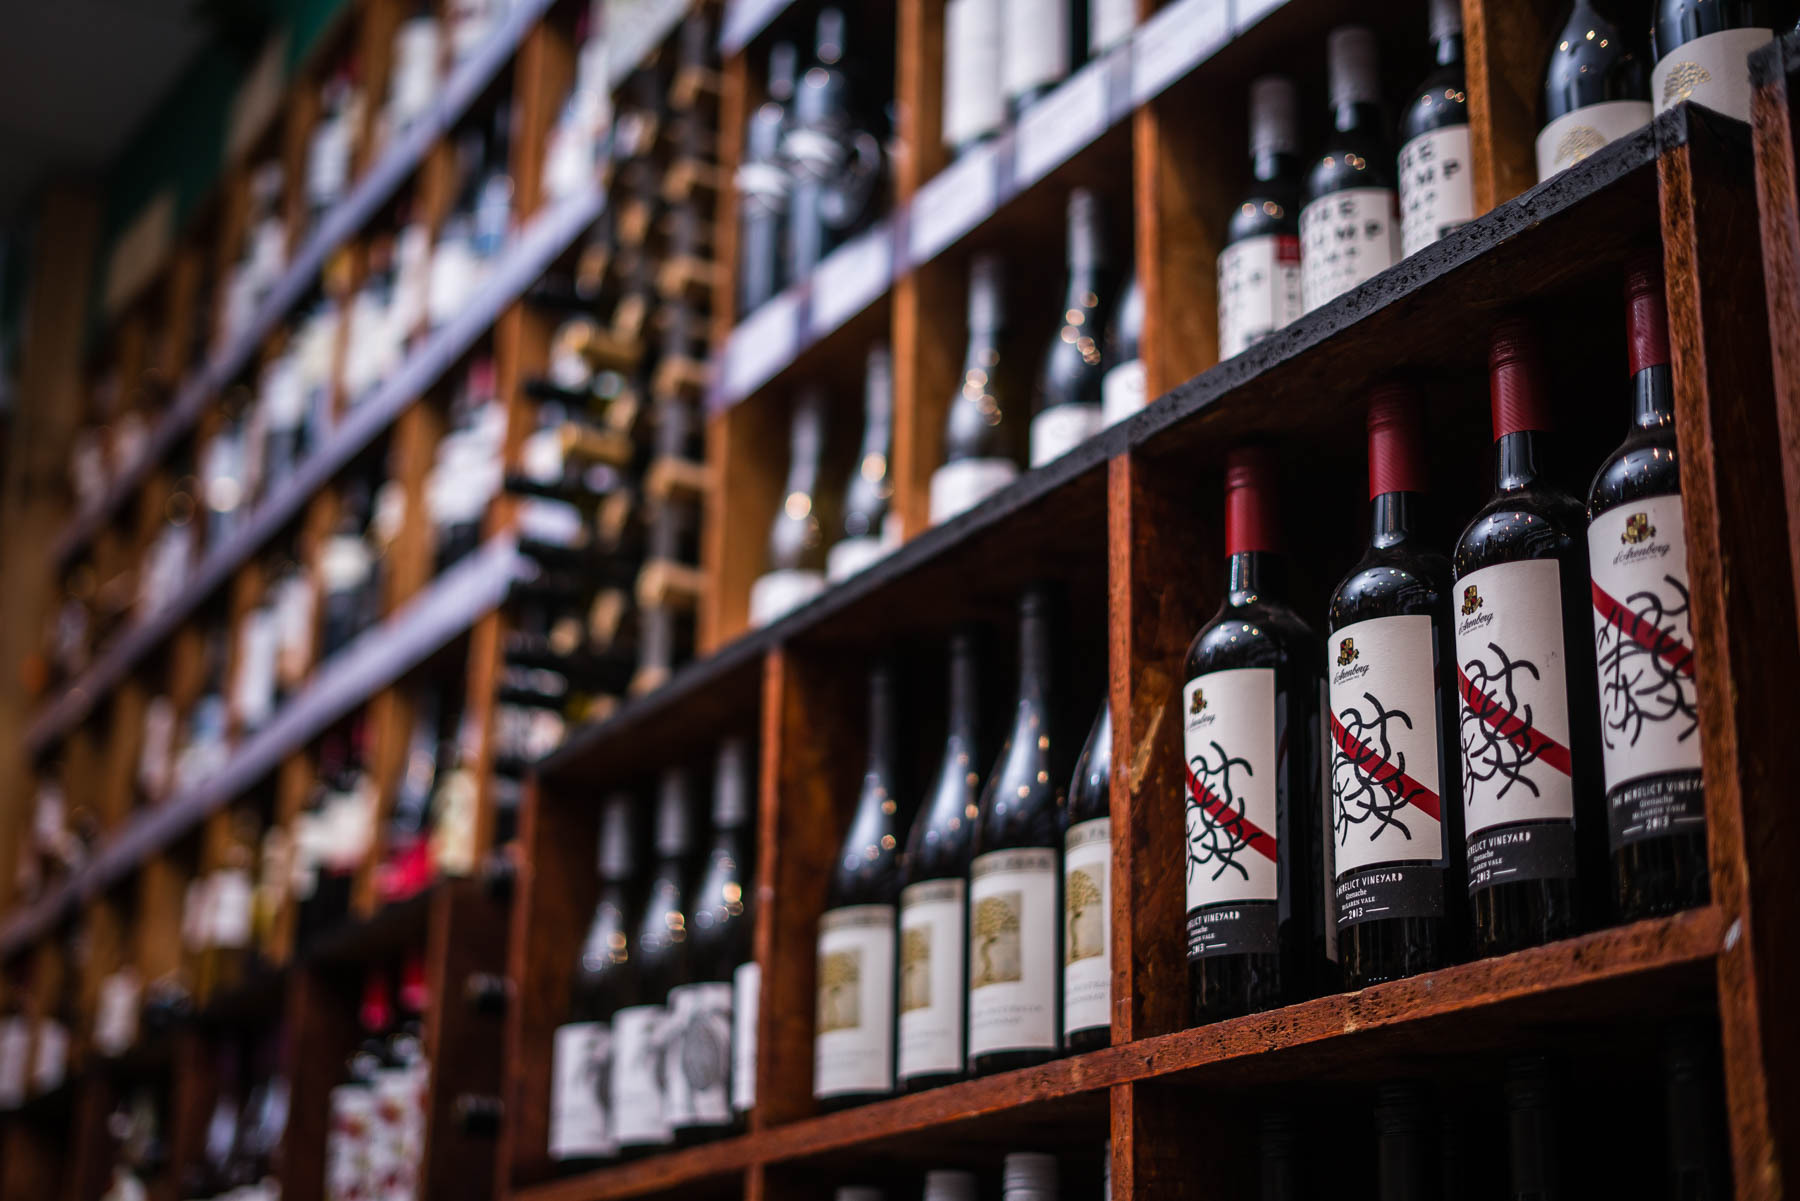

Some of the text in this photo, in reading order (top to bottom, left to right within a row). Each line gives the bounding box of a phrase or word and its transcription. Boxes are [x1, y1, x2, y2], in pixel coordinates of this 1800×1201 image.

[1624, 782, 1662, 803] DERELICT
[1666, 778, 1705, 792] VINEYA
[1646, 815, 1670, 832] 2013
[1488, 832, 1532, 847] VINEYARD
[1362, 873, 1403, 886] VINEYARD
[1477, 870, 1490, 883] 2013
[1361, 896, 1376, 904] VALE
[1203, 911, 1241, 923] VINEYARD
[1348, 907, 1363, 919] 2013
